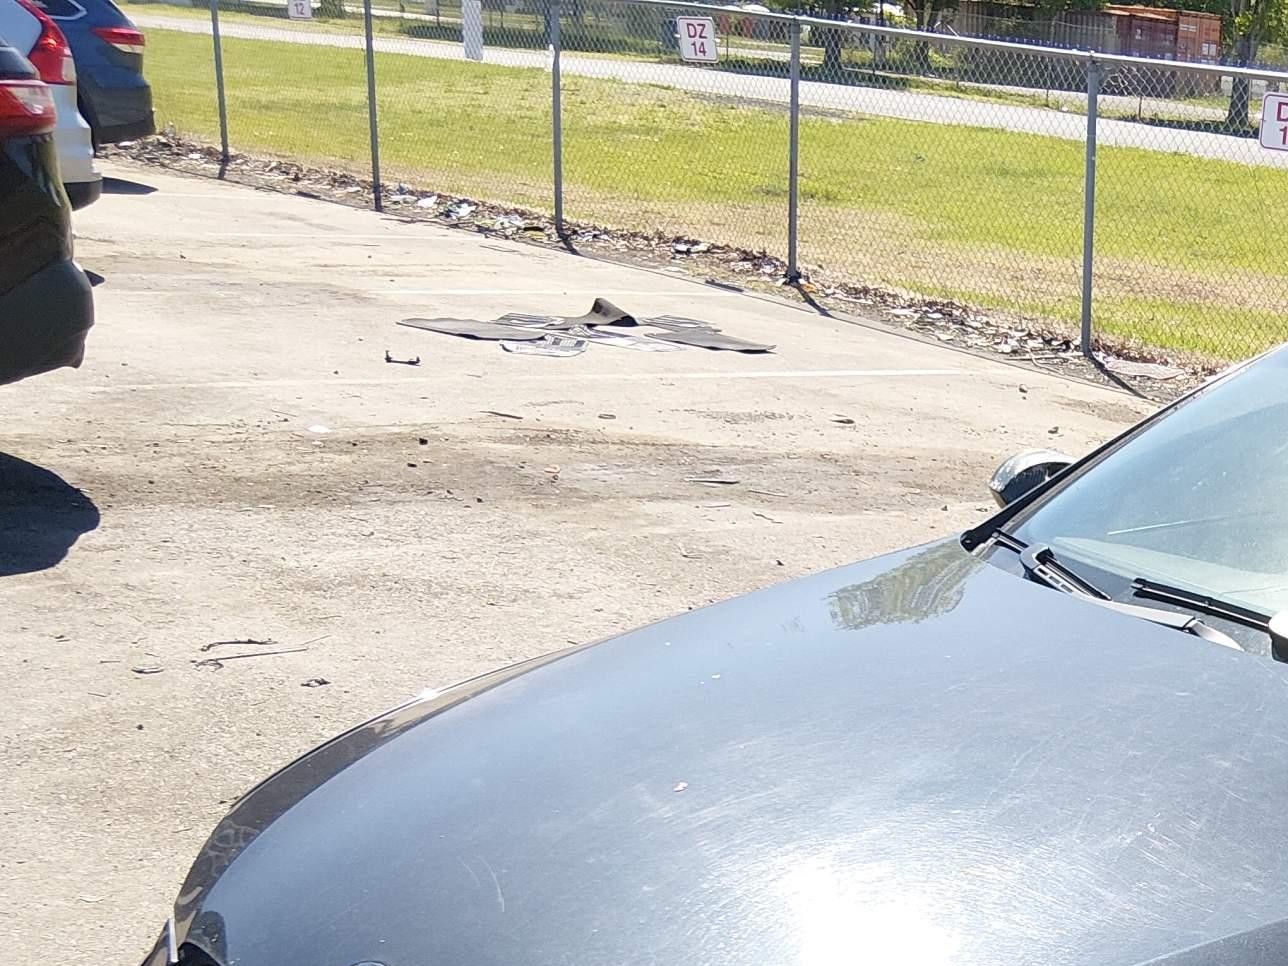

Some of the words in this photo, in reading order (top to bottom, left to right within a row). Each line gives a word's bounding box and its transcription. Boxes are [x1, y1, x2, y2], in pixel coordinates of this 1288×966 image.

[294, 2, 305, 16] 12
[686, 22, 708, 39] DZ
[691, 41, 707, 57] 14
